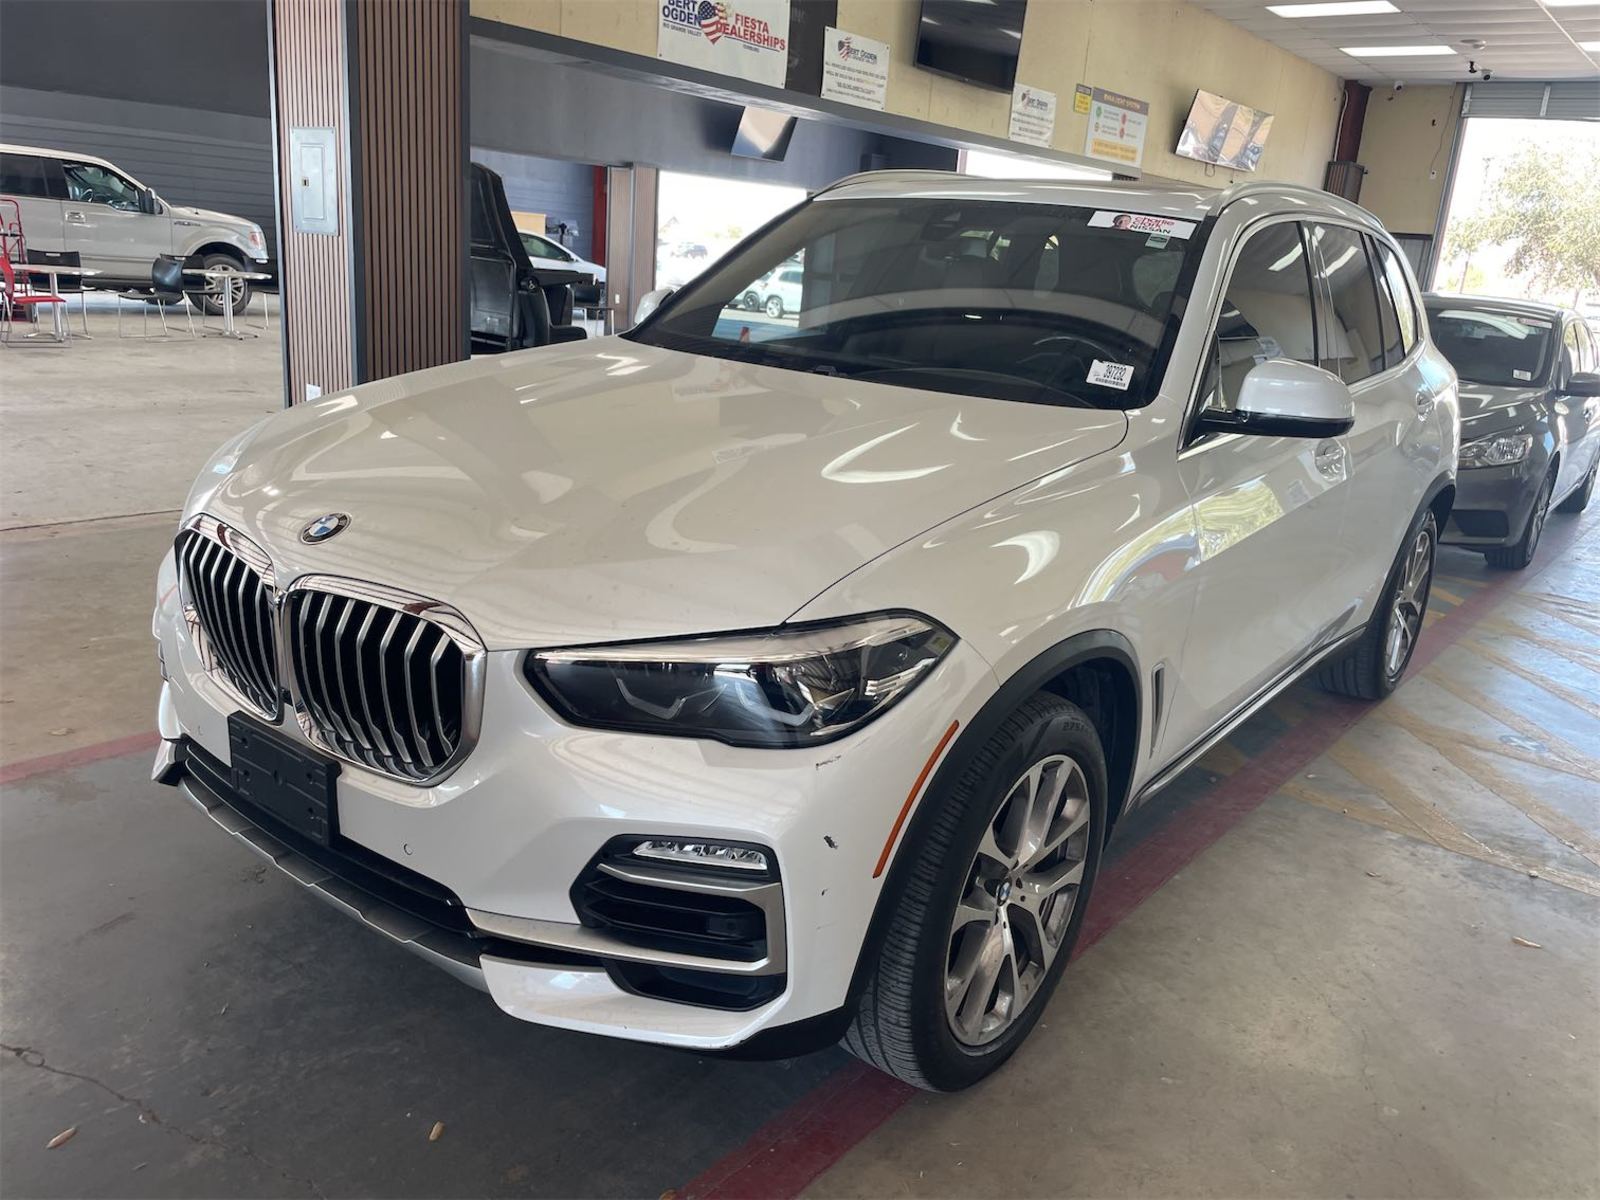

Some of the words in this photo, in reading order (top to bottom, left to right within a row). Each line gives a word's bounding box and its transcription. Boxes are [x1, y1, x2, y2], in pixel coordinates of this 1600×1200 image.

[662, 5, 702, 27] OGDEN
[668, 0, 697, 11] BERT
[735, 13, 769, 34] FIESTA
[716, 22, 786, 51] DEALERSHIPS
[1130, 224, 1171, 234] NISSAN
